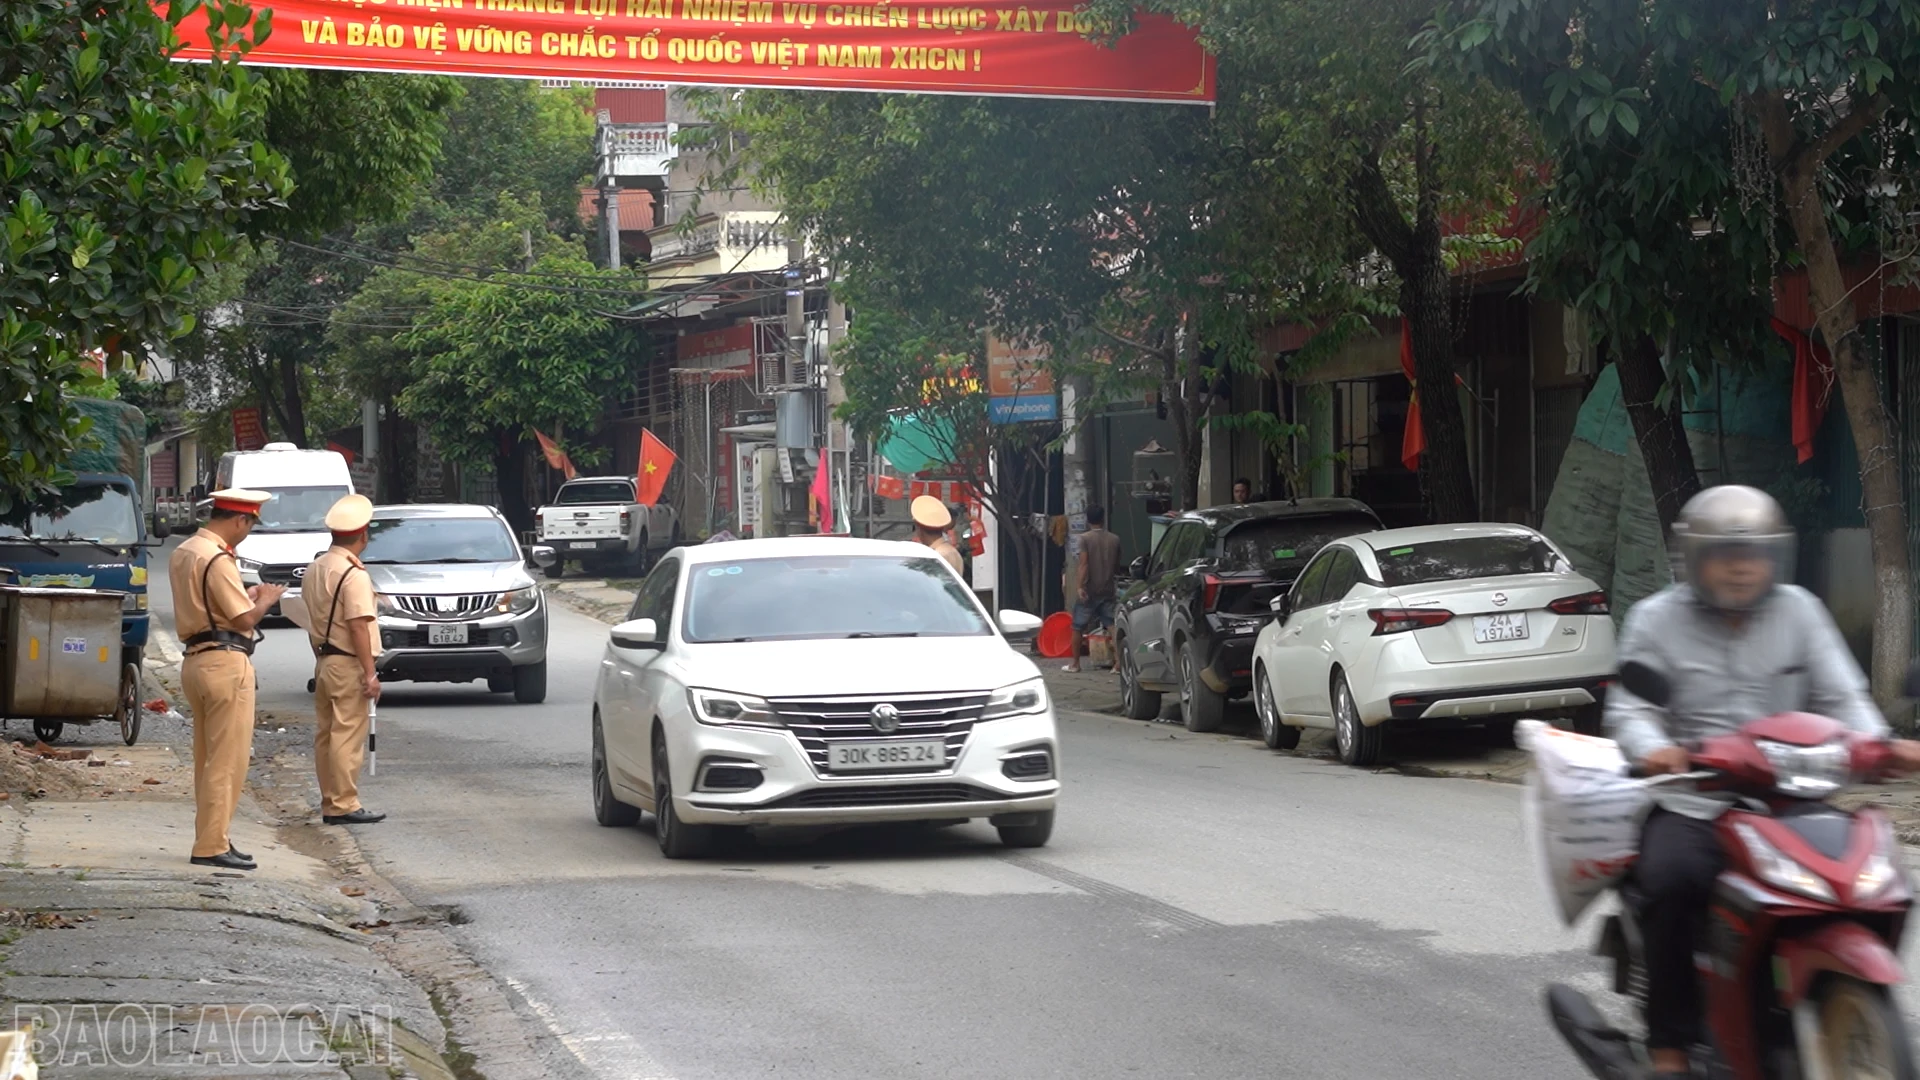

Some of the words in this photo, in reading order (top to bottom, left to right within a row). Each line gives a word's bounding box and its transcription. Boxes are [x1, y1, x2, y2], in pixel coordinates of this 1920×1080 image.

[626, 0, 672, 19] HAI
[682, 0, 773, 26] NHIỆM
[783, 3, 817, 29] VỤ
[825, 0, 908, 28] CHIẾN
[917, 6, 987, 35] LƯỢC
[995, 6, 1049, 33] XÂY
[301, 16, 338, 45] VÀ
[347, 16, 404, 48] BẢO
[413, 22, 447, 55] VỆ
[456, 24, 532, 54] VỮNG
[541, 25, 616, 58] CHẮC
[625, 28, 661, 60] TỔ
[667, 32, 743, 64] QUỐC
[751, 38, 809, 70] VIỆT
[817, 44, 882, 68] NAM
[890, 46, 965, 71] XHCN
[973, 49, 981, 71] !
[1489, 615, 1512, 627] 24A
[440, 625, 457, 634] 29H
[1482, 626, 1523, 641] 197.15
[839, 746, 935, 763] 30K-885.24
